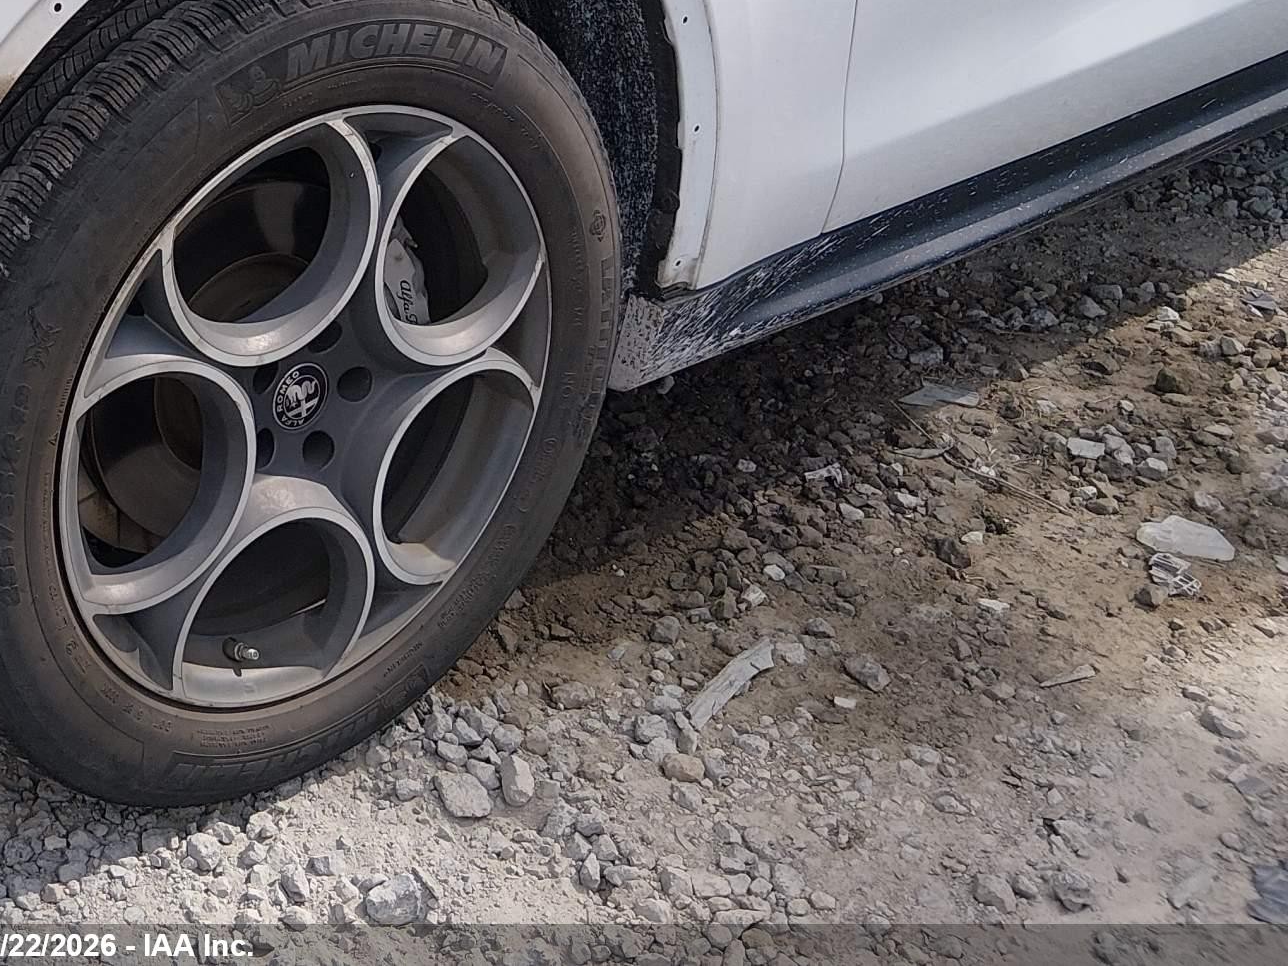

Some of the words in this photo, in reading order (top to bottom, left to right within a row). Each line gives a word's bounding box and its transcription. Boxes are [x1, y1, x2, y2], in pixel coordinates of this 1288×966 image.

[286, 22, 509, 82] MICHELIN
[397, 279, 414, 313] Alfa
[276, 370, 300, 412] ROMEO
[281, 414, 305, 427] ALFA
